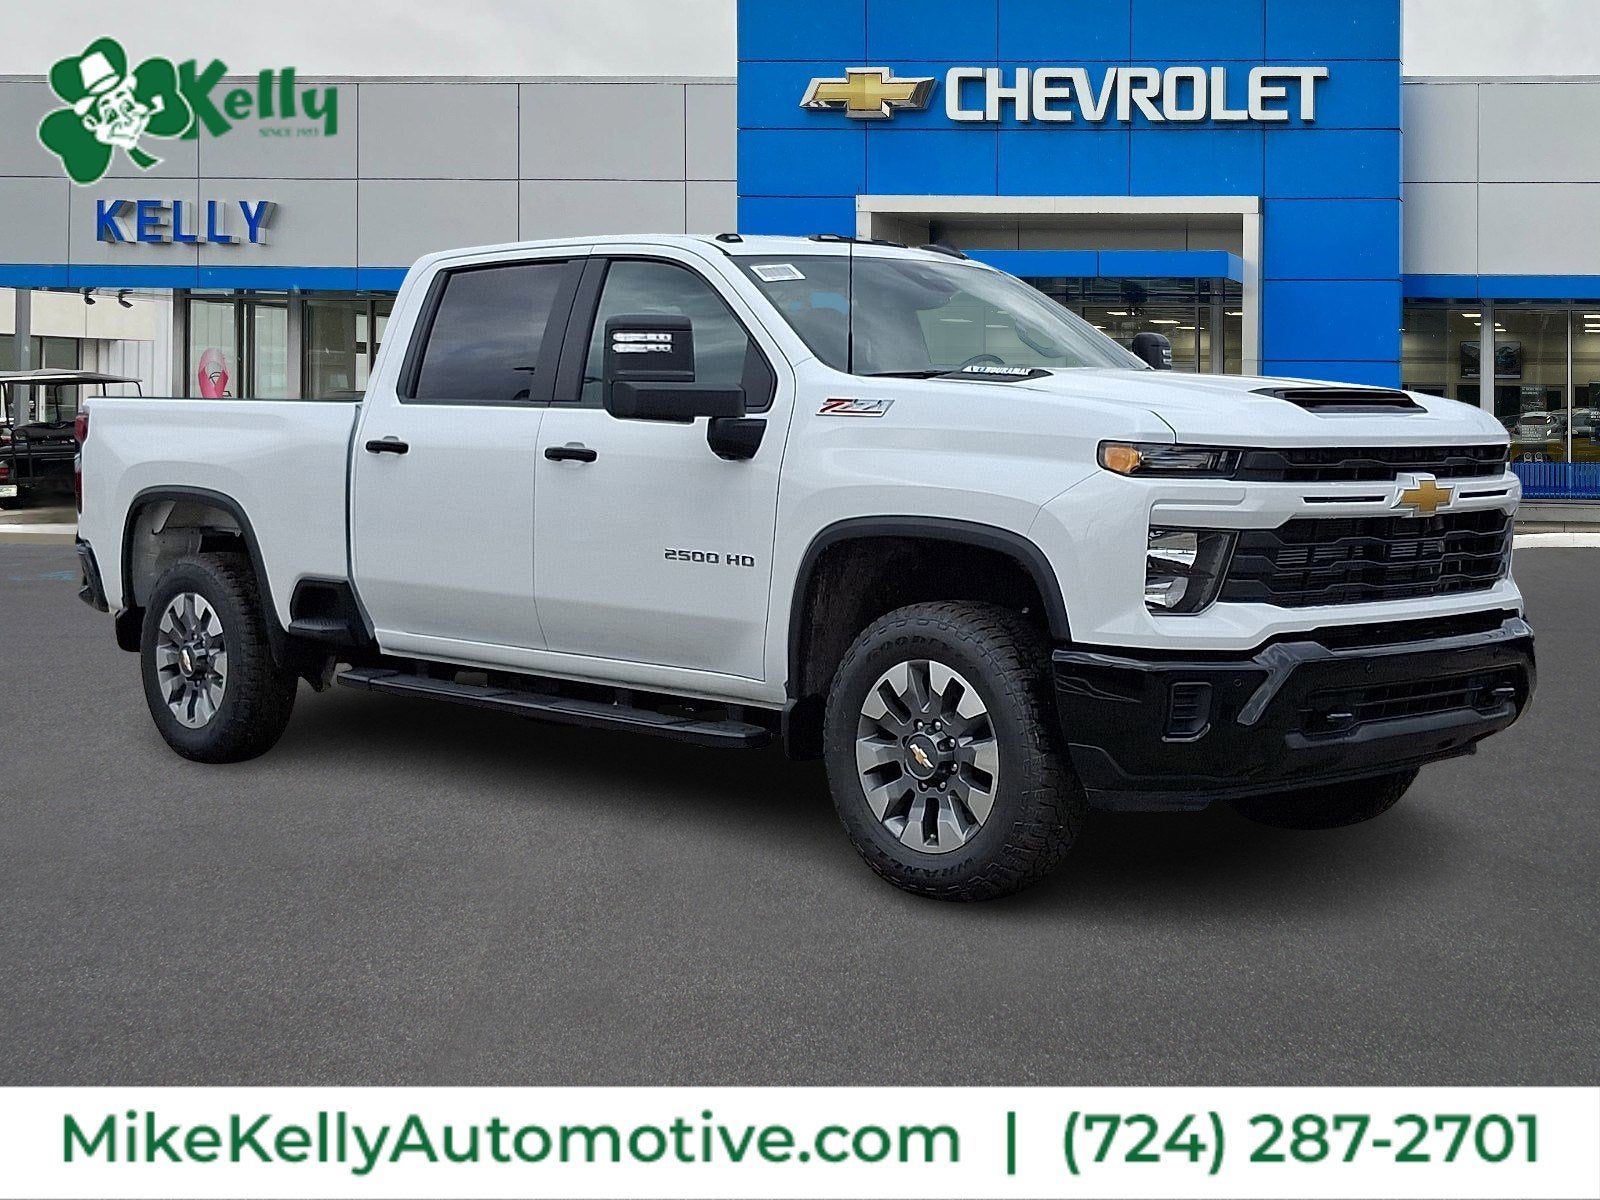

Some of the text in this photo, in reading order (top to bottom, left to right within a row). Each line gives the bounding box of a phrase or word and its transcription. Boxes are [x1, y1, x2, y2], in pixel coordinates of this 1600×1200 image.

[945, 66, 1328, 122] CHEVROLET
[96, 199, 275, 245] KELLY
[664, 548, 755, 568] 2500 HD
